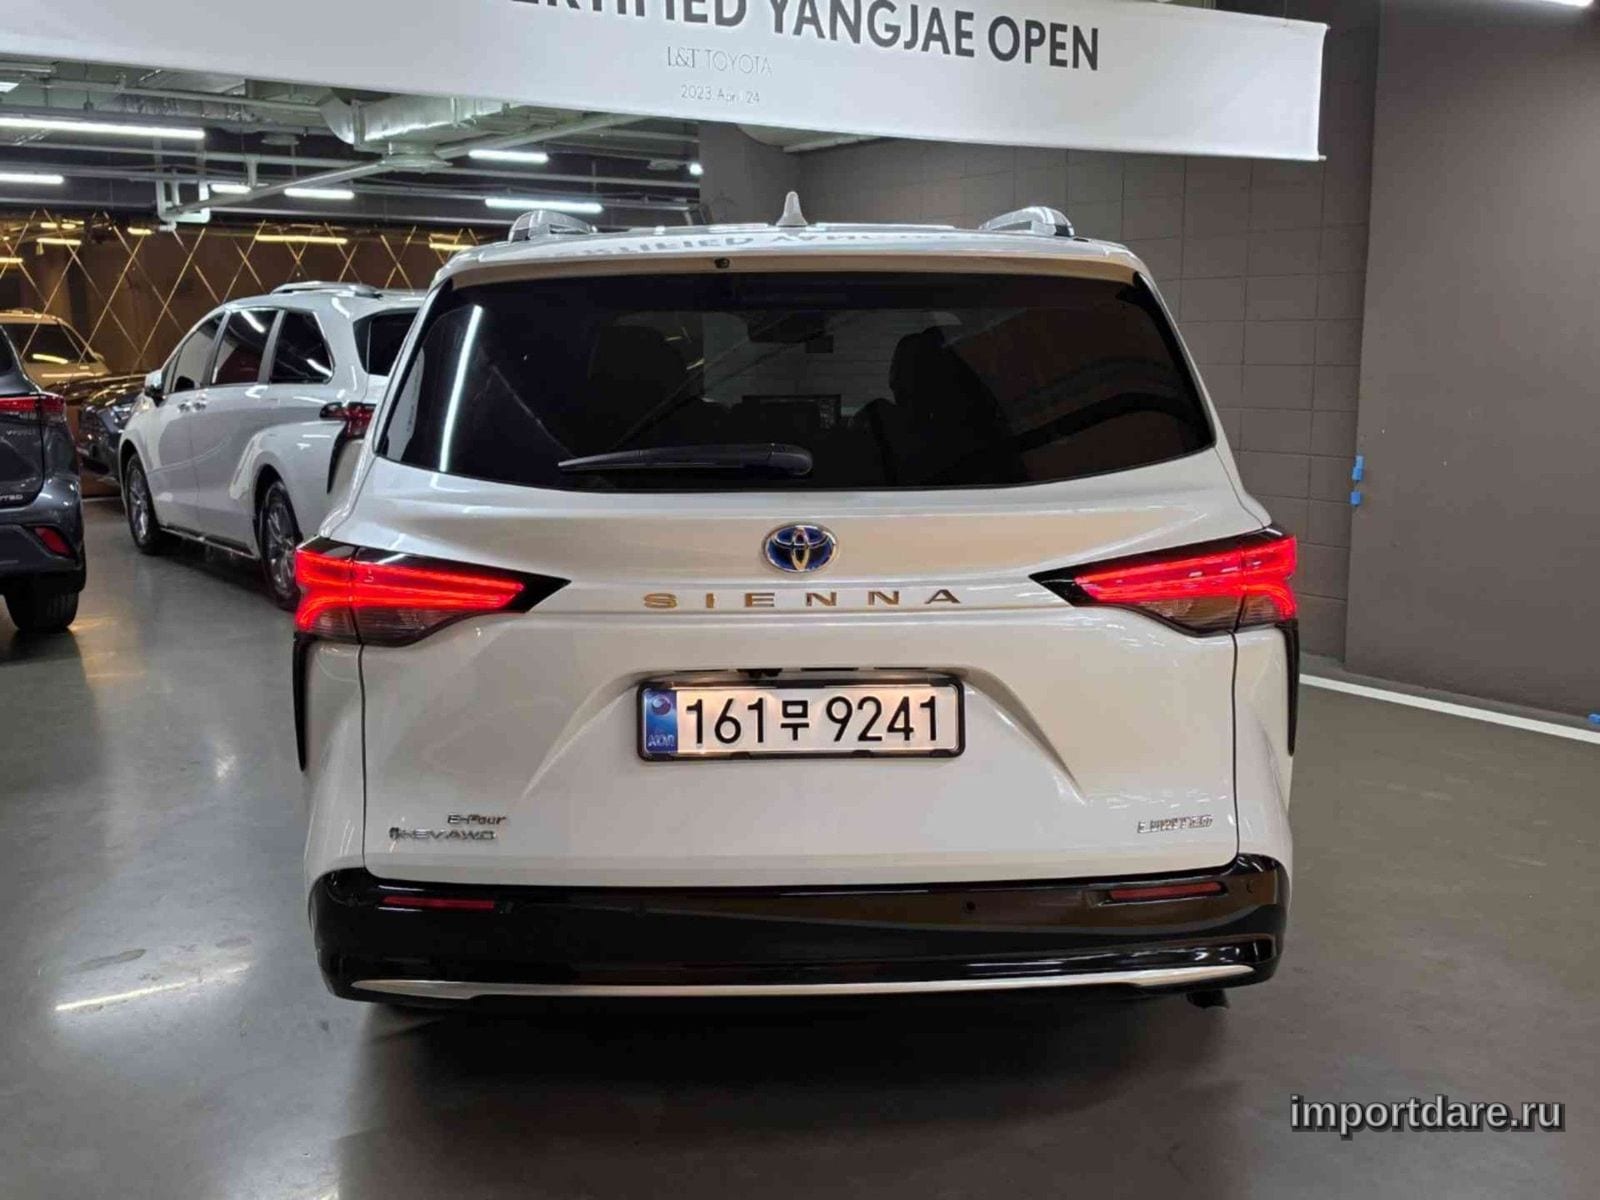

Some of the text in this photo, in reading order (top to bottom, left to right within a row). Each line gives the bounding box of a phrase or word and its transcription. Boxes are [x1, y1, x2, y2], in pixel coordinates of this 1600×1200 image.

[768, 0, 975, 57] YANGJAE
[988, 15, 1098, 71] OPEN
[705, 49, 772, 74] TOYOTA
[680, 84, 712, 100] 2023
[643, 588, 961, 609] SIENNA
[825, 695, 937, 742] 9241
